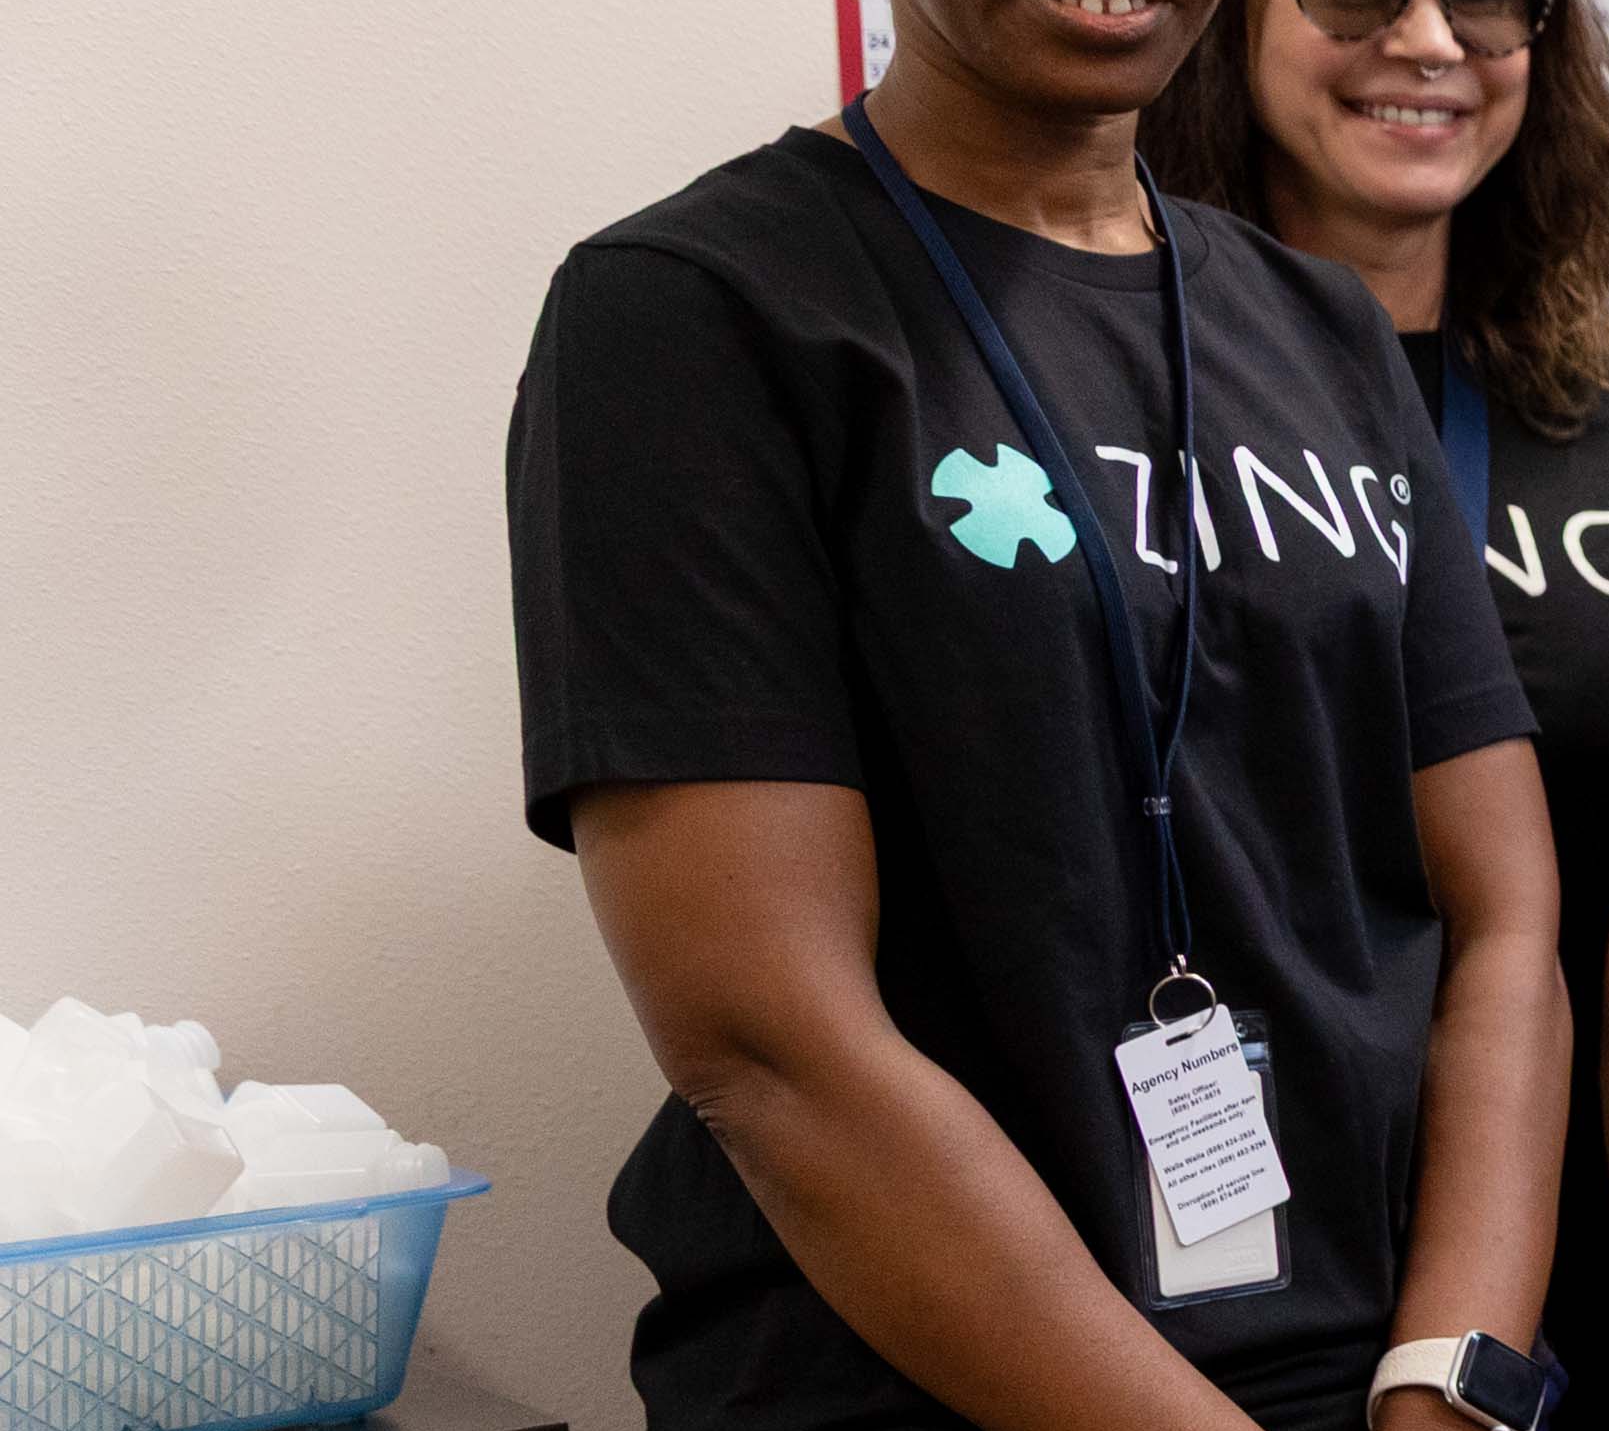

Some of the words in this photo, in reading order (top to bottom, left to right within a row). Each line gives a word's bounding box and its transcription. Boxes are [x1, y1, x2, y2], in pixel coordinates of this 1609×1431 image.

[1131, 1068, 1179, 1095] Agency
[1181, 1041, 1239, 1073] Numbers
[1168, 1092, 1192, 1107] Safety
[1148, 1123, 1189, 1146] Emergency
[1223, 1101, 1239, 1113] after
[1166, 1138, 1180, 1149] and
[1192, 1117, 1228, 1137] weekends
[1163, 1161, 1184, 1174] Walla
[1184, 1152, 1205, 1165] Walla
[1167, 1179, 1178, 1189] All
[1179, 1171, 1198, 1183] other
[1199, 1163, 1217, 1174] sites
[1177, 1189, 1216, 1210] Disruption
[1216, 1183, 1224, 1193] of
[1225, 1172, 1250, 1188] service
